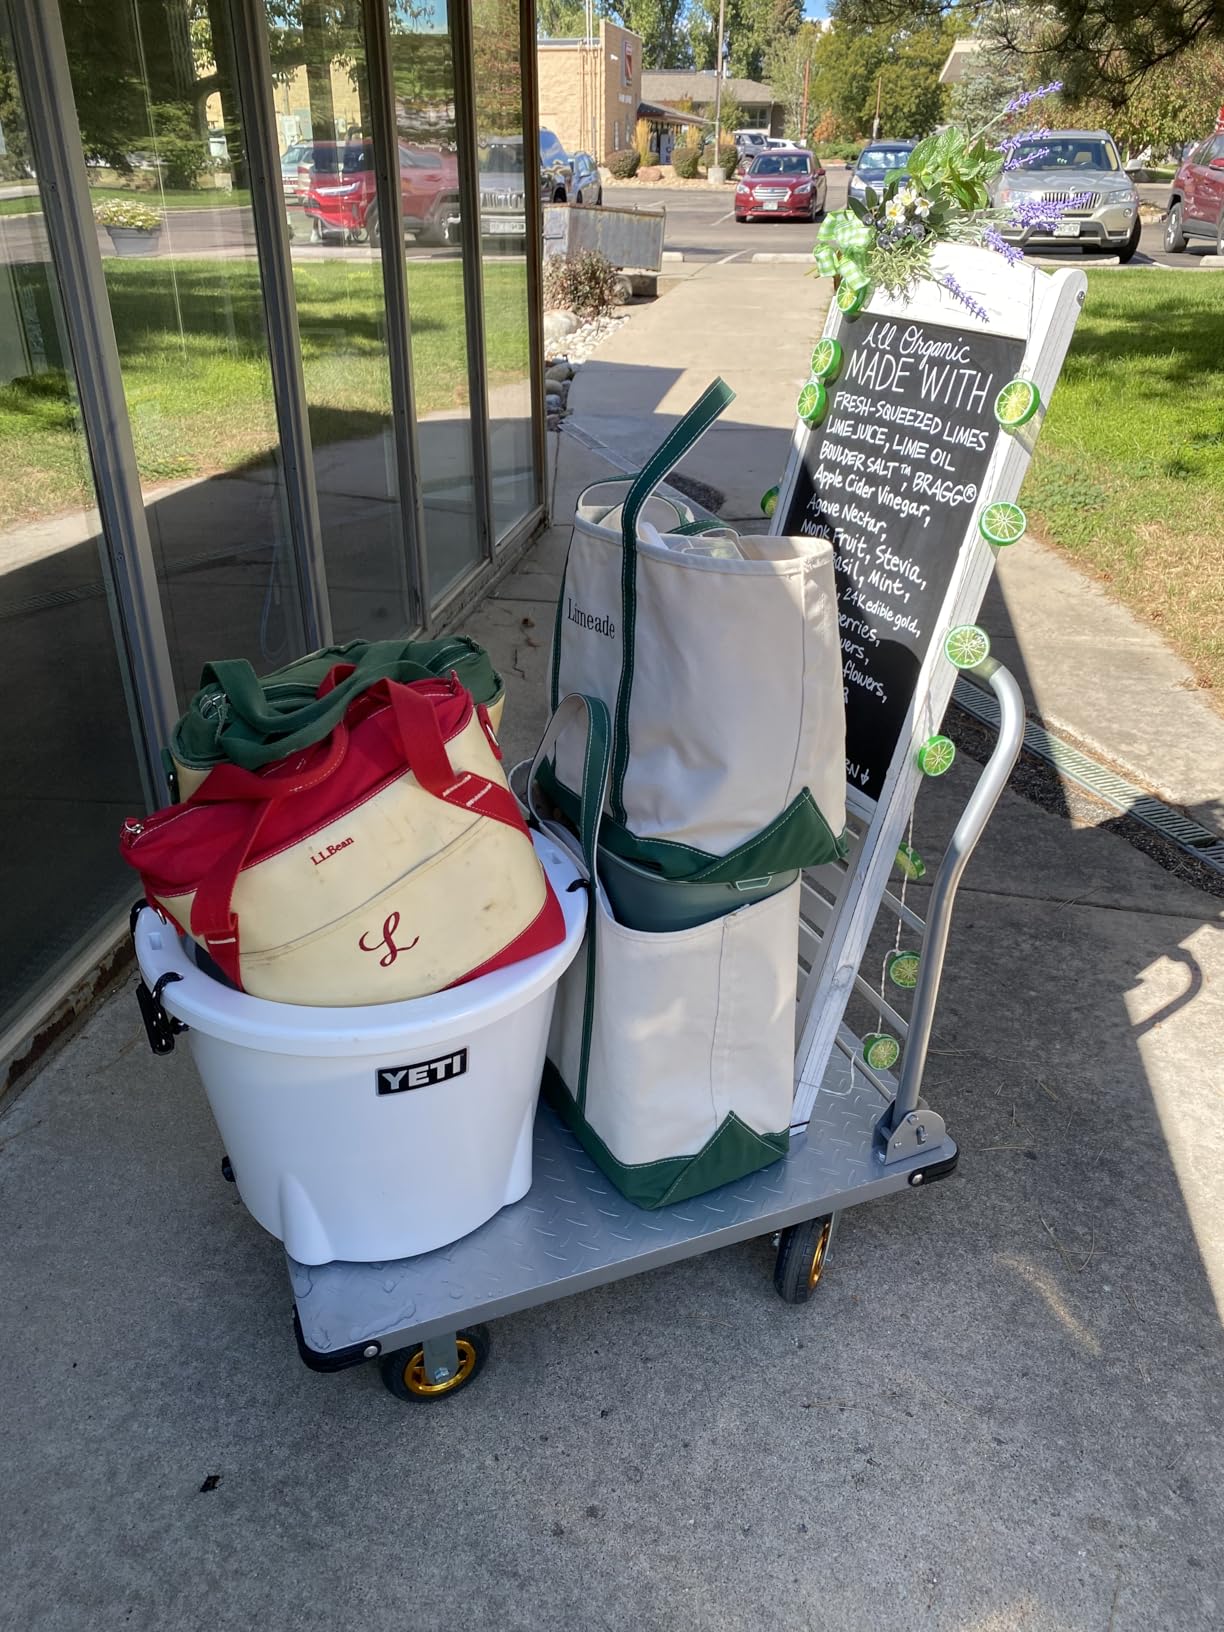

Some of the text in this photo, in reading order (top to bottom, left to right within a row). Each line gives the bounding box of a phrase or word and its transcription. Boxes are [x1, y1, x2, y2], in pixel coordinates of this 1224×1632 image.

[862, 322, 971, 369] All Organic
[845, 349, 993, 414] MADE WITH
[826, 415, 853, 438] LIME
[892, 434, 929, 459] LIME
[930, 448, 956, 472] OIL
[833, 391, 989, 452] FRESH-SQUEEZED LIMES
[819, 440, 866, 472] BOULDER
[806, 493, 887, 542] Agave Nectar,
[813, 463, 932, 528] Apple Cider Vinegar,
[800, 519, 927, 591] Monk Fruit, Stevia,
[868, 569, 910, 604] Mint,
[567, 597, 616, 640] Limeade
[866, 600, 894, 621] edible
[893, 614, 921, 638] gold,
[381, 1054, 462, 1090] YETI
